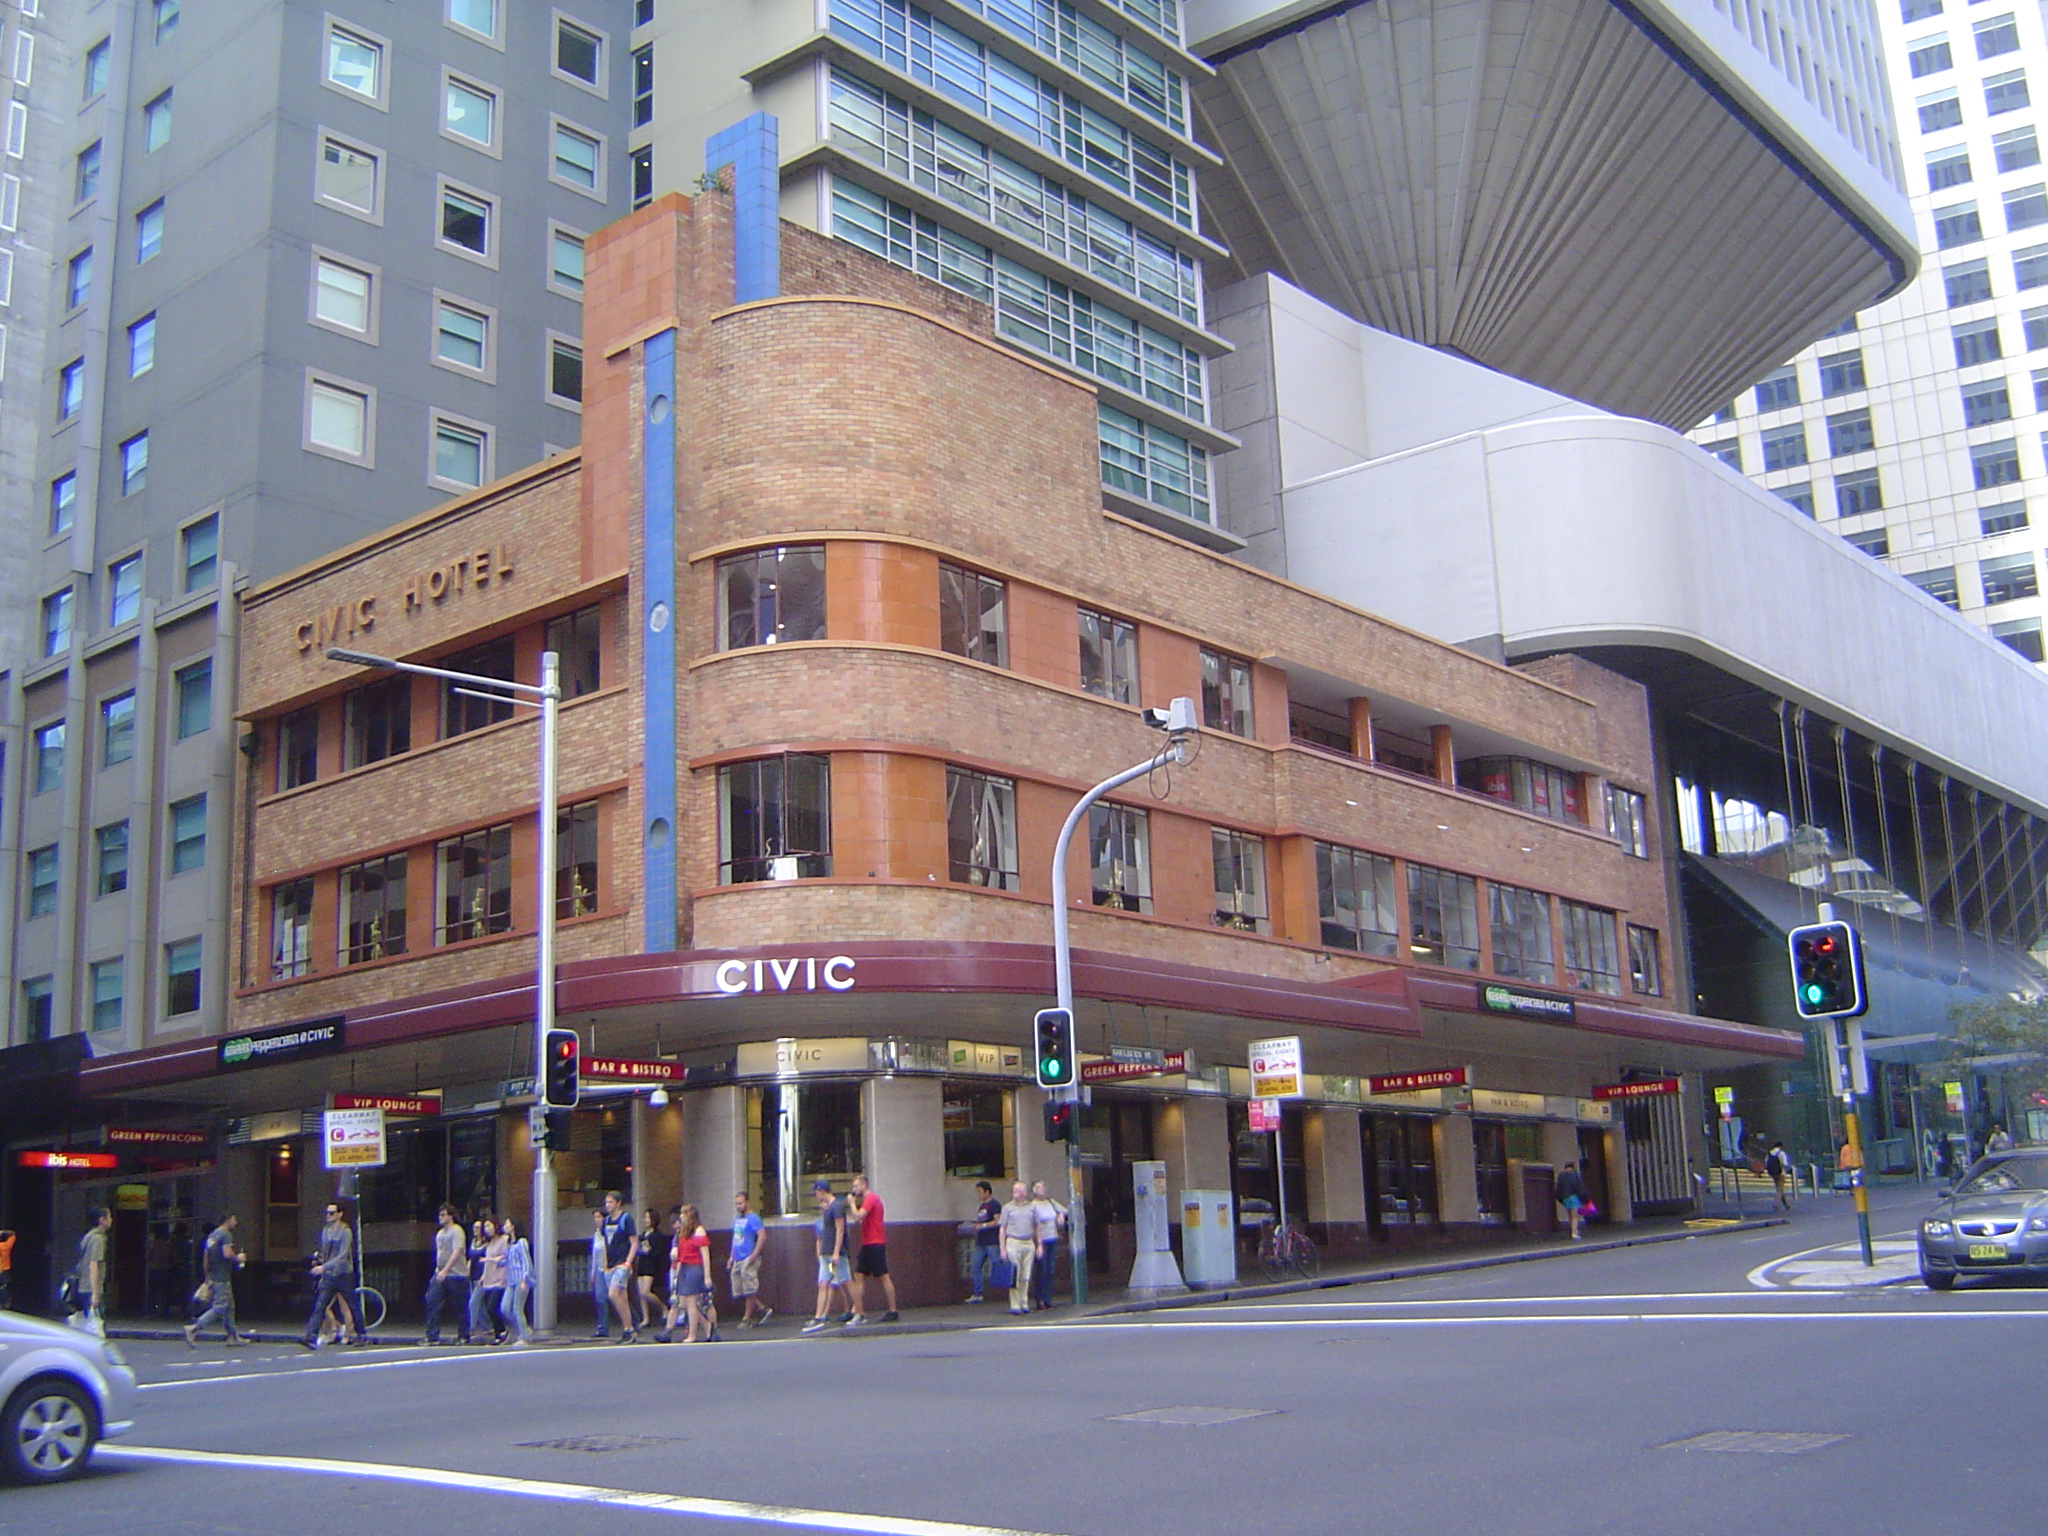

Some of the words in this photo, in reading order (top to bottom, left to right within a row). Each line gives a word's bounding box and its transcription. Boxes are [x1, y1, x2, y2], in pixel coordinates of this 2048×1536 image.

[296, 596, 376, 651] CIVIC
[404, 544, 513, 611] HOTEL
[716, 956, 856, 993] CIVIC
[307, 1027, 335, 1040] CIVIC
[1253, 1041, 1292, 1050] CLEARWAY
[776, 1049, 822, 1062] CIVIC
[977, 1053, 995, 1064] VIP
[593, 1061, 615, 1072] BAR
[620, 1063, 628, 1073] &
[632, 1064, 671, 1075] BISTRO
[1083, 1063, 1115, 1077] GREEN
[1383, 1078, 1401, 1087] BAR
[1406, 1076, 1413, 1085] &
[1418, 1072, 1453, 1083] BISTRO
[1608, 1086, 1622, 1096] VIP
[1626, 1083, 1663, 1094] LOUNGE
[354, 1098, 372, 1107] VIP
[377, 1099, 422, 1110] LOUNGE
[332, 1111, 377, 1120] CLEARWAY
[111, 1130, 142, 1140] GREEN
[144, 1132, 204, 1142] PEPPERCORN
[48, 1153, 67, 1167] ibis
[69, 1158, 90, 1167] HOTEL
